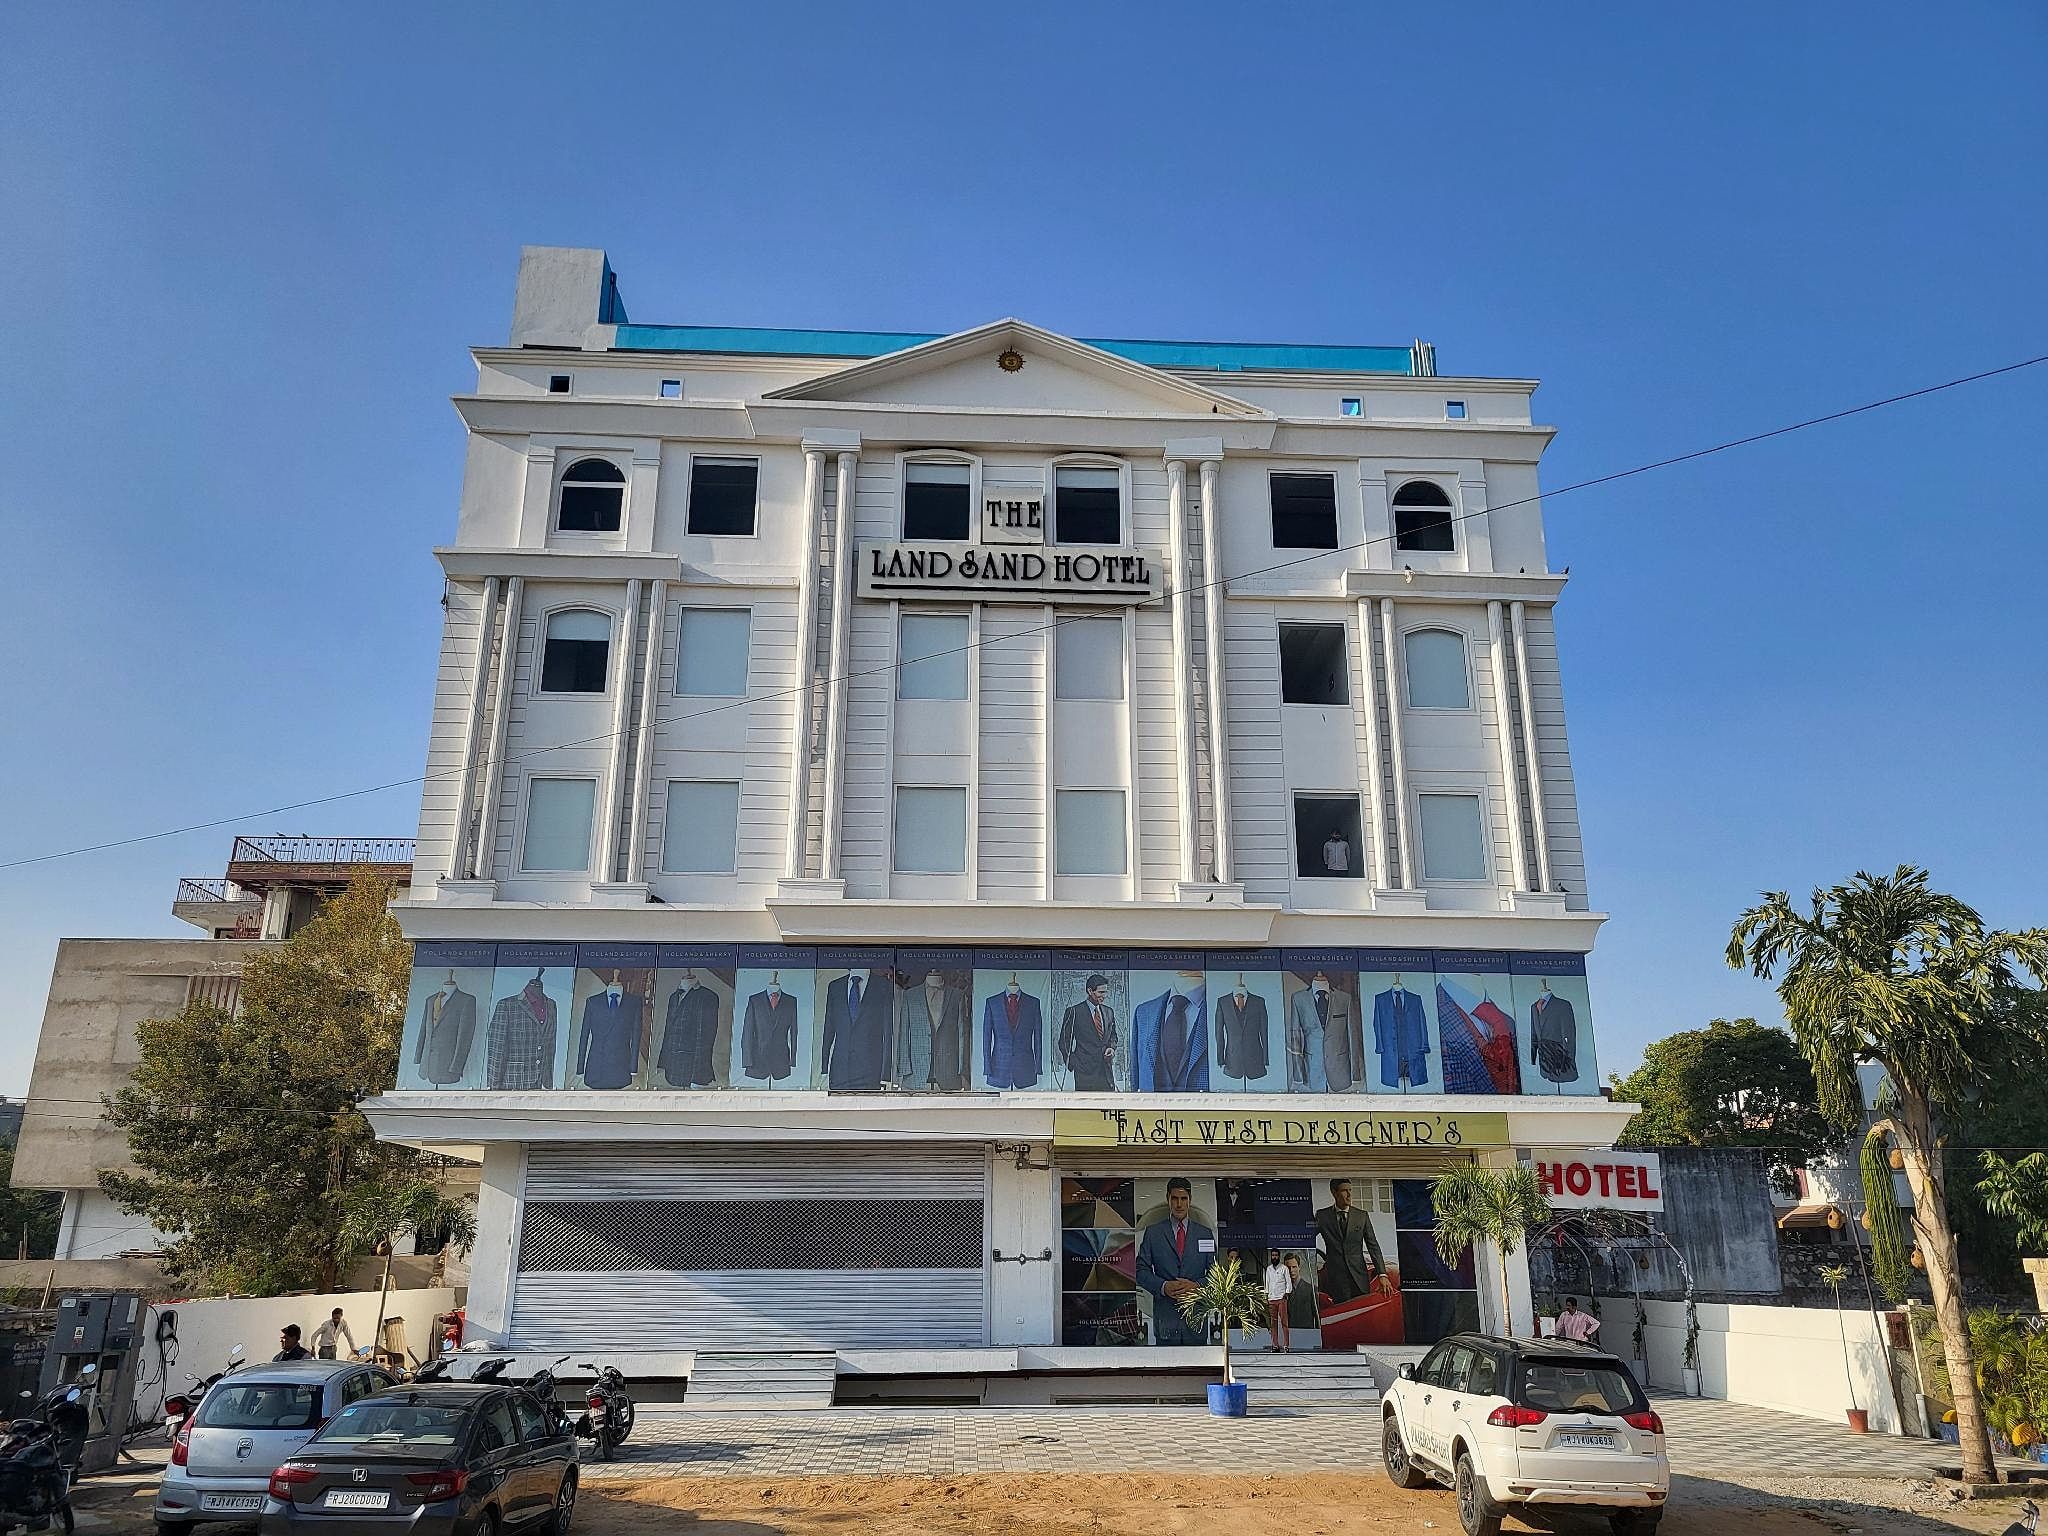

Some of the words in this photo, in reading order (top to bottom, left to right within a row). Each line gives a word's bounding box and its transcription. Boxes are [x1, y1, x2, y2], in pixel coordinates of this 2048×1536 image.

[987, 500, 1041, 529] THE
[871, 550, 953, 578] LAND
[958, 549, 1046, 581] SAND
[1053, 554, 1151, 584] HOTEL
[1101, 1110, 1126, 1121] THE
[1116, 1119, 1184, 1144] EAST
[1195, 1119, 1272, 1145] WEST
[1284, 1115, 1462, 1146] DESIGNER'S
[1537, 1162, 1659, 1199] HOTEL
